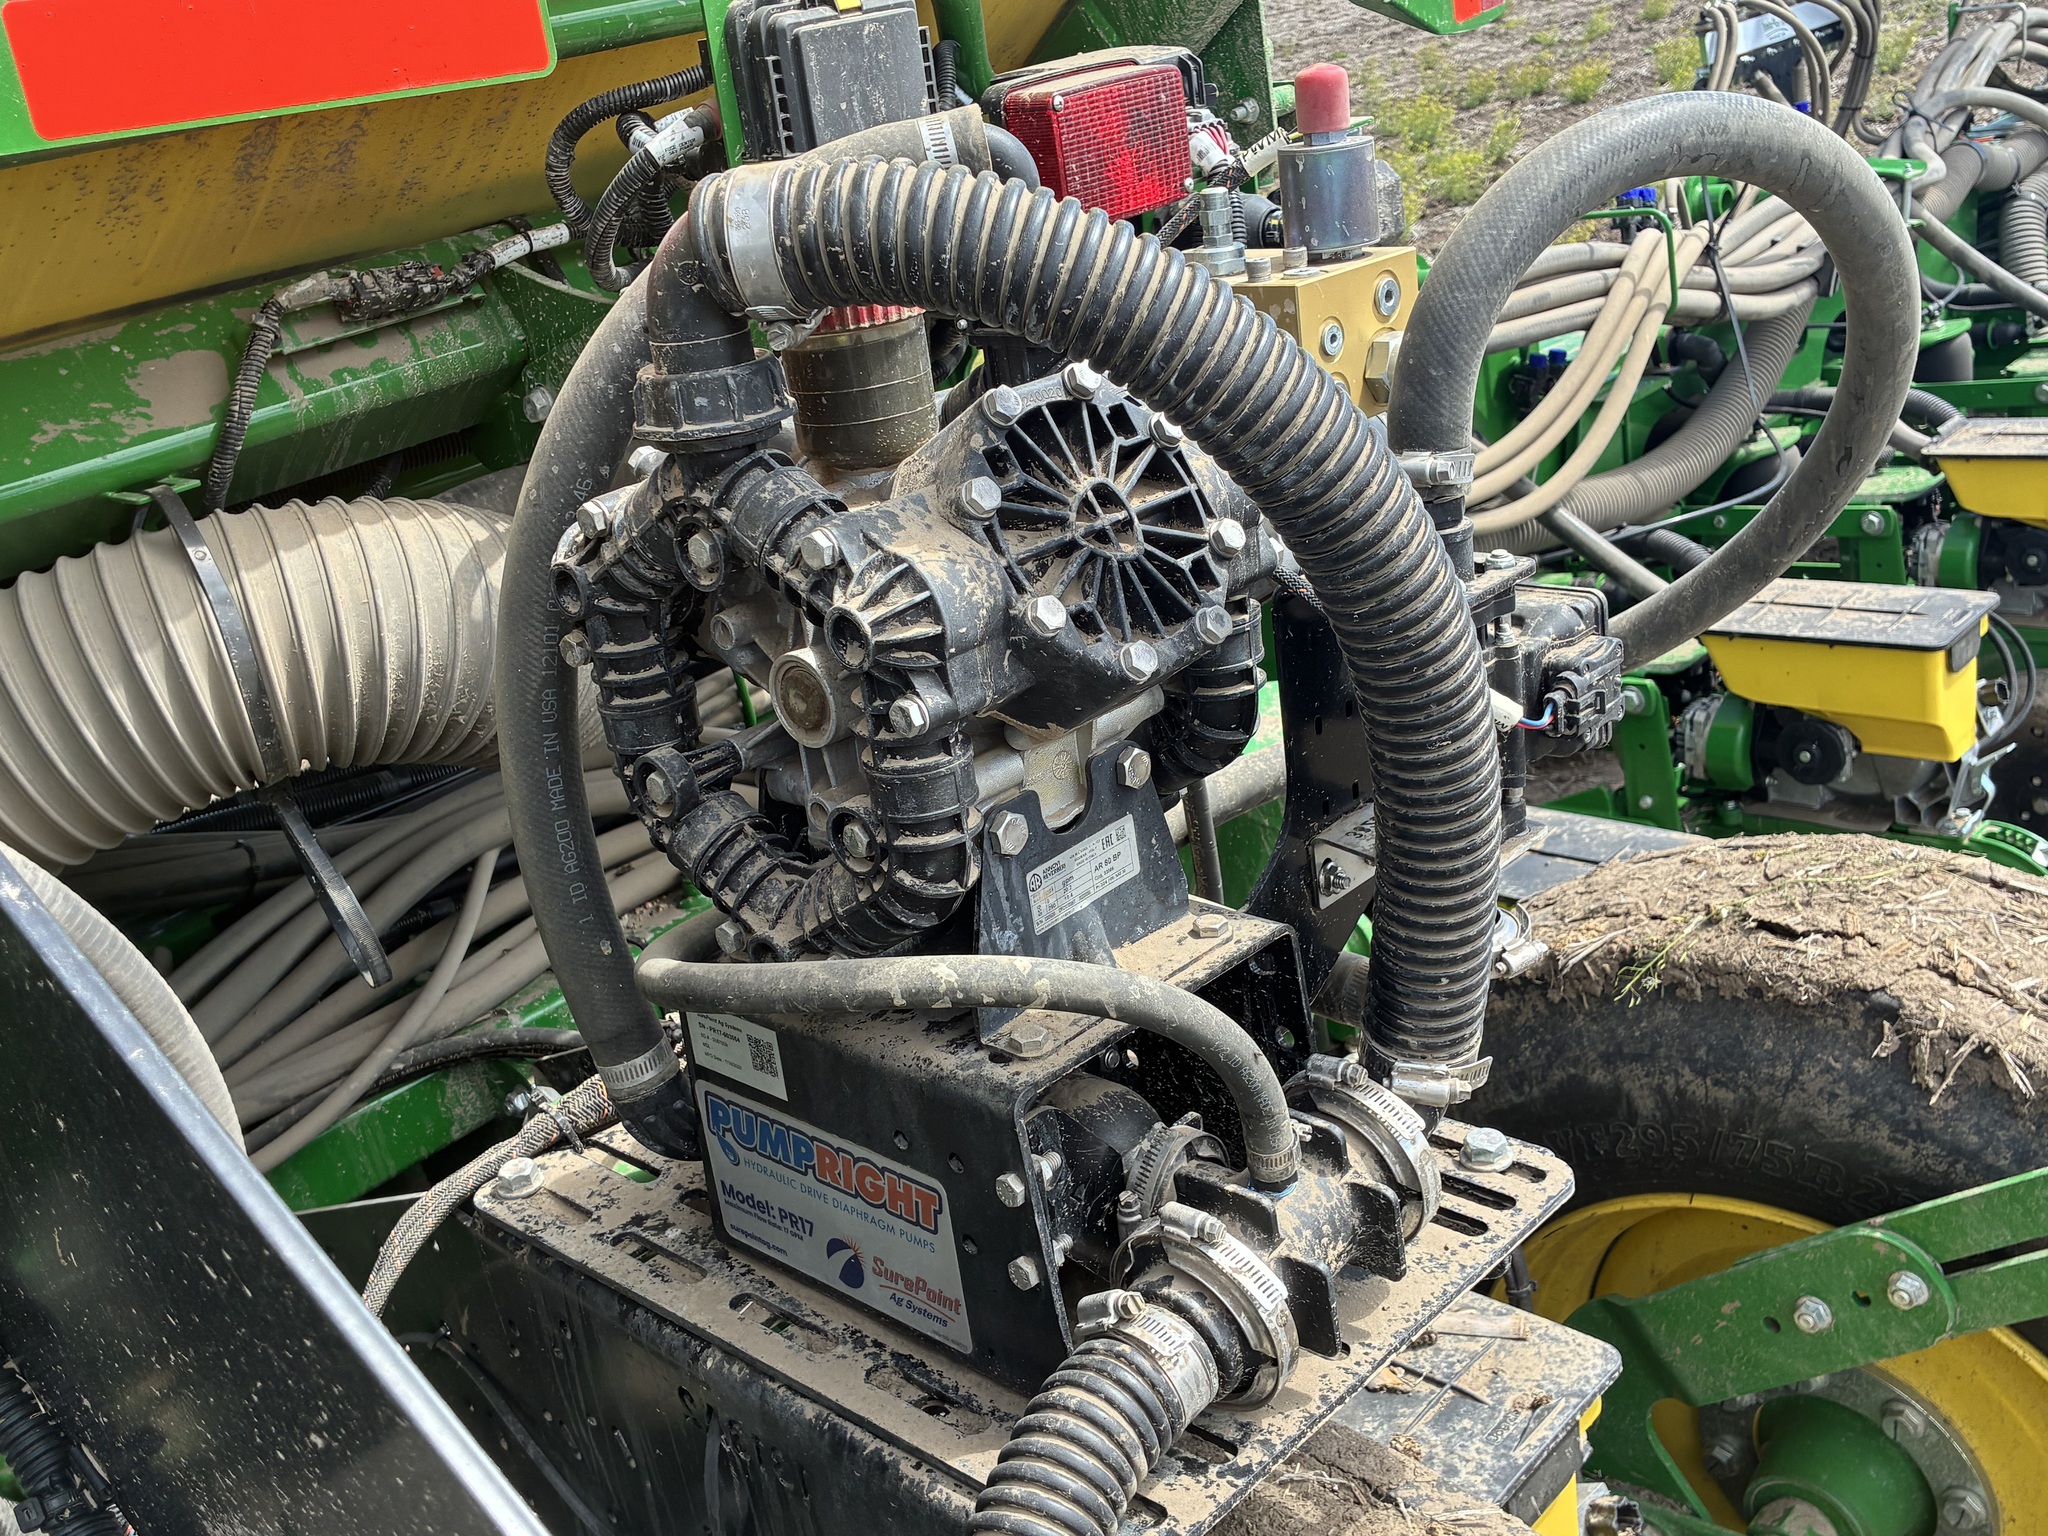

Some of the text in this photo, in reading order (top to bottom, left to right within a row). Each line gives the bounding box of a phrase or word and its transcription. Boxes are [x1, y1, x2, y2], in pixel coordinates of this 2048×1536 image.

[541, 689, 558, 723] USA
[543, 732, 560, 755] IN
[545, 764, 567, 812] MADE
[555, 819, 580, 874] AG200
[569, 877, 588, 905] ID
[707, 1093, 941, 1232] PUMPRIGHT
[720, 1179, 814, 1238] Model: PR17
[743, 1156, 936, 1254] HYDRAULIC DRIVE DIAPHRAGM PUMPS
[872, 1255, 963, 1316] SurePoint
[889, 1291, 949, 1328] Ag Systems
